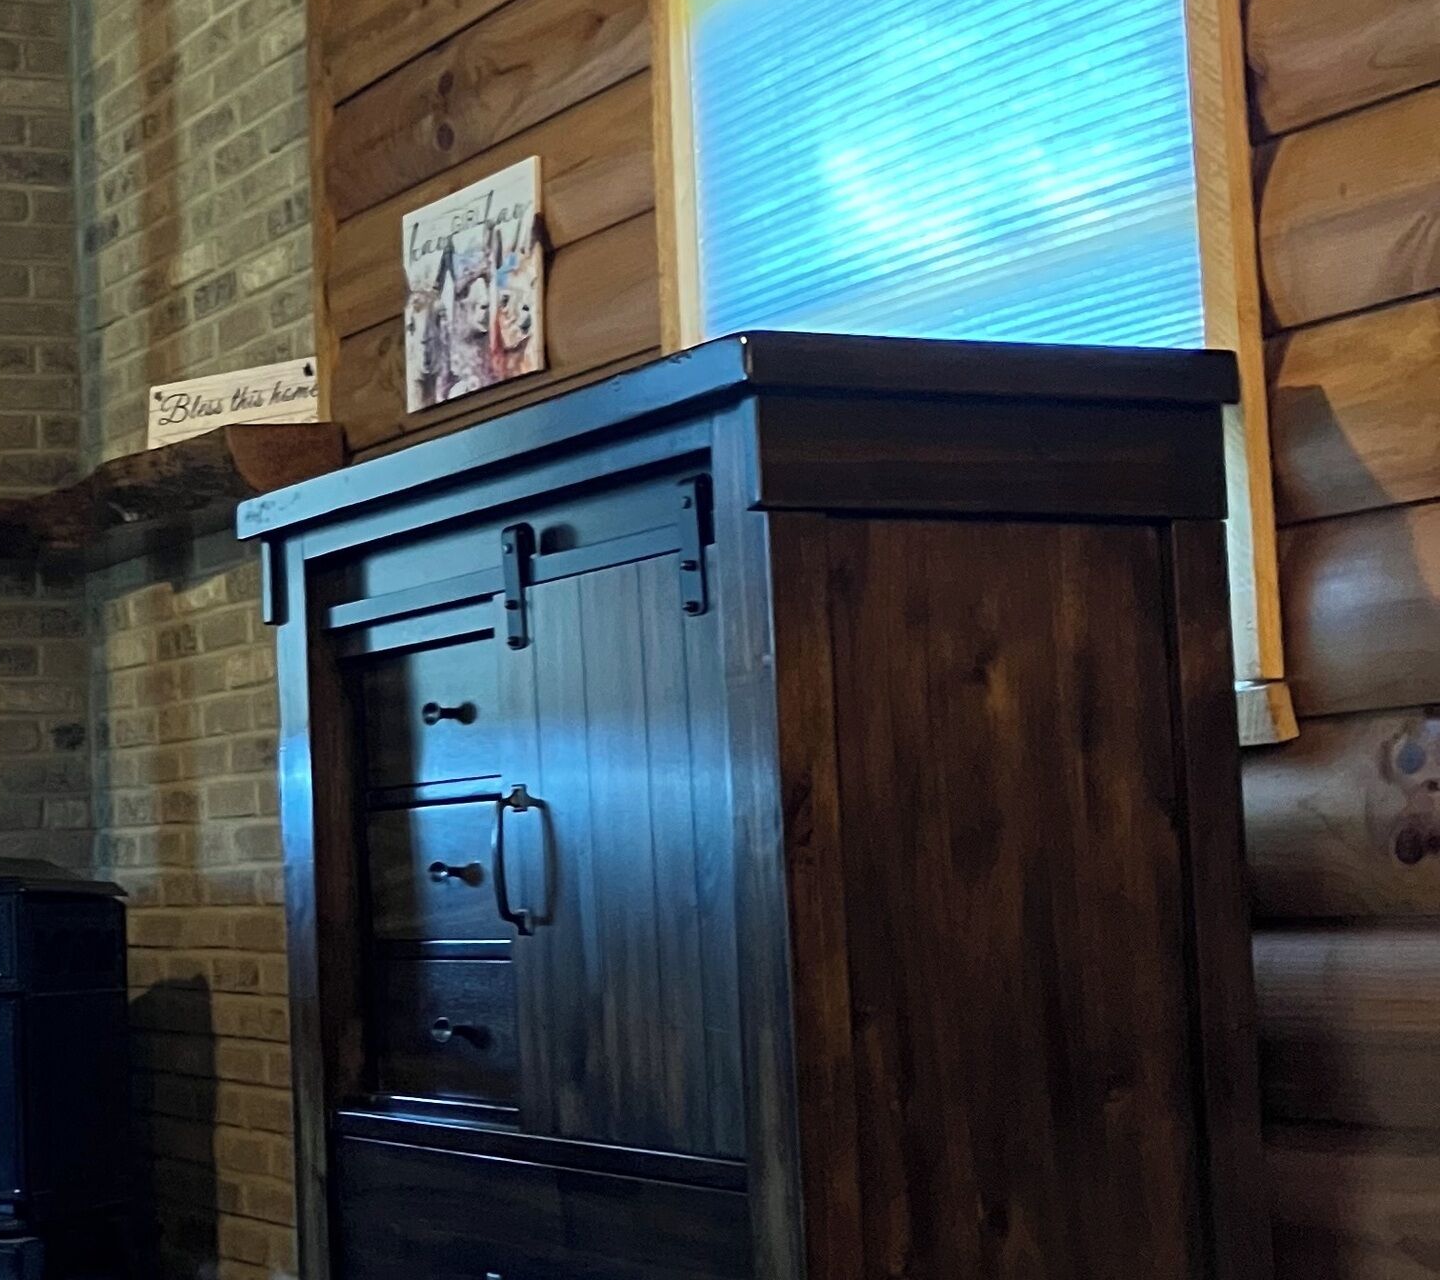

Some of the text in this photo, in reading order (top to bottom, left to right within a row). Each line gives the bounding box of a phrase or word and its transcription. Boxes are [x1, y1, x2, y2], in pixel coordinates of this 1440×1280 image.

[160, 380, 318, 425] Bless this home
